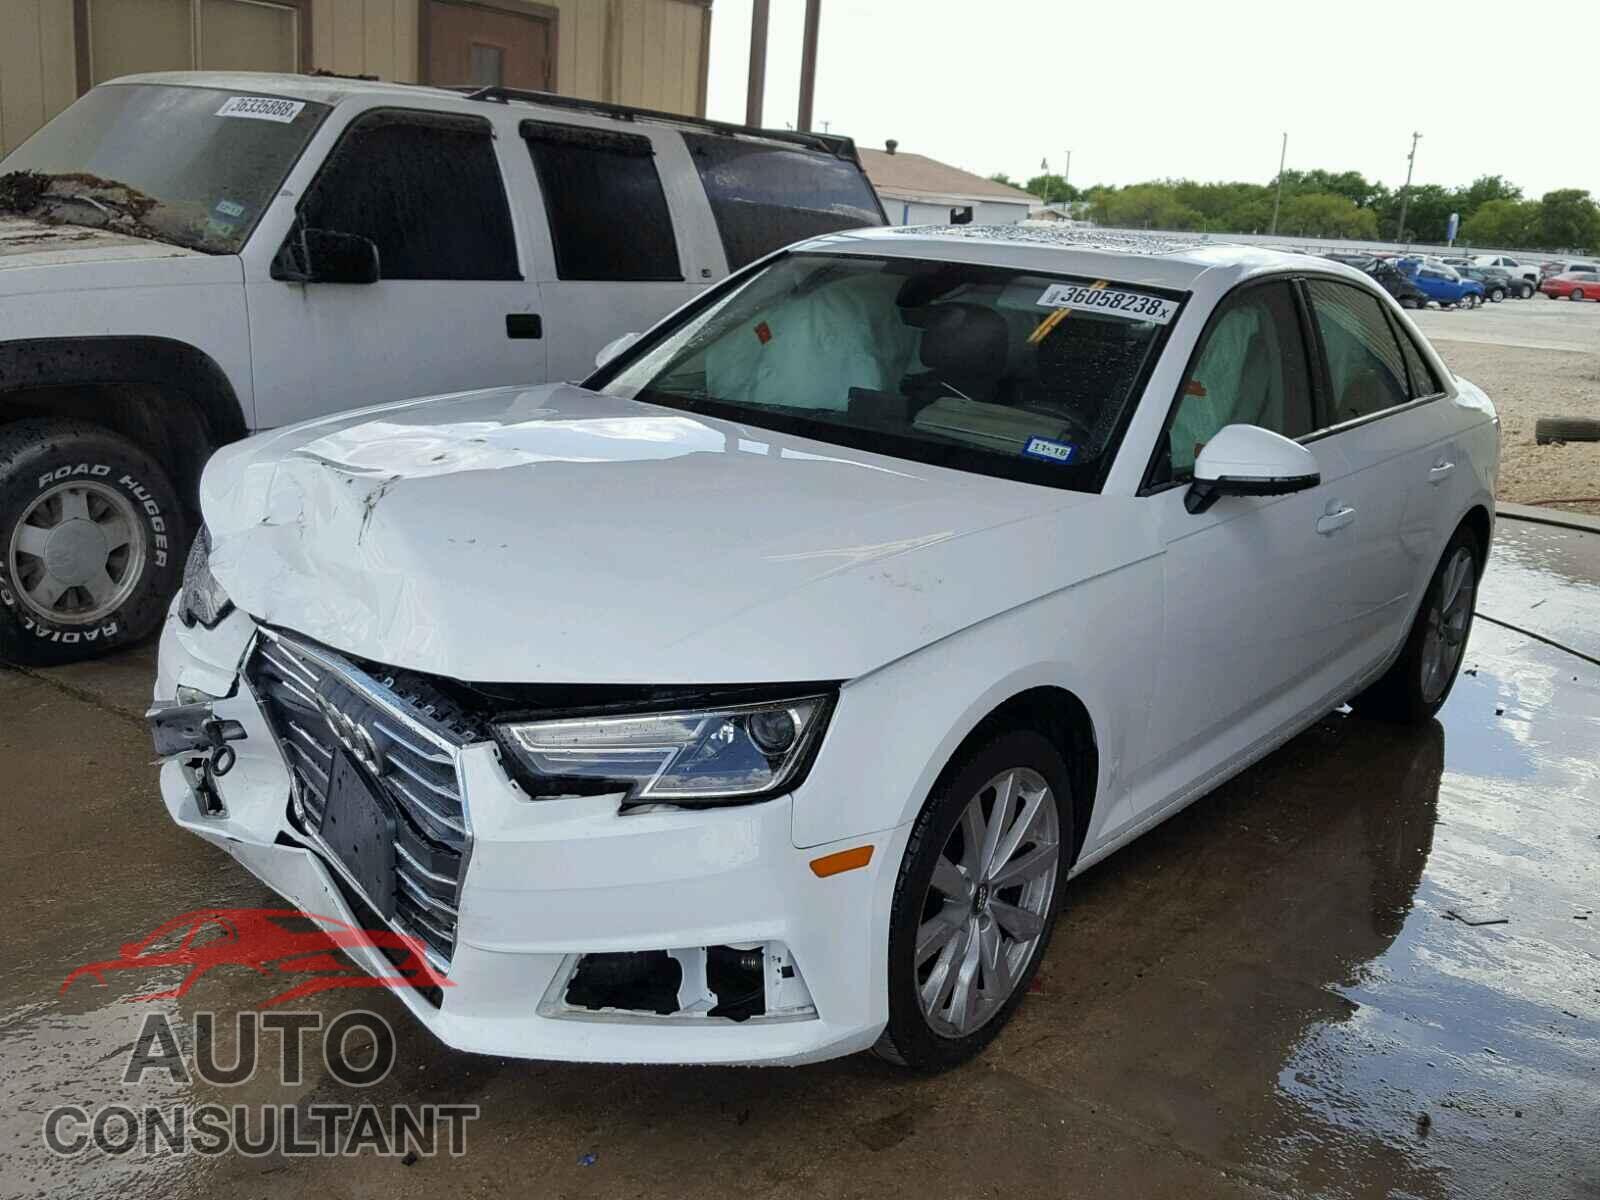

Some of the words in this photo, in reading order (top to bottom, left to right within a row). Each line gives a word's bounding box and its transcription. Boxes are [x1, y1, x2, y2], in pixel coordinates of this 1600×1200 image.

[38, 463, 112, 489] ROAD
[118, 474, 169, 568] HUGGER
[24, 616, 119, 644] RADIAL
